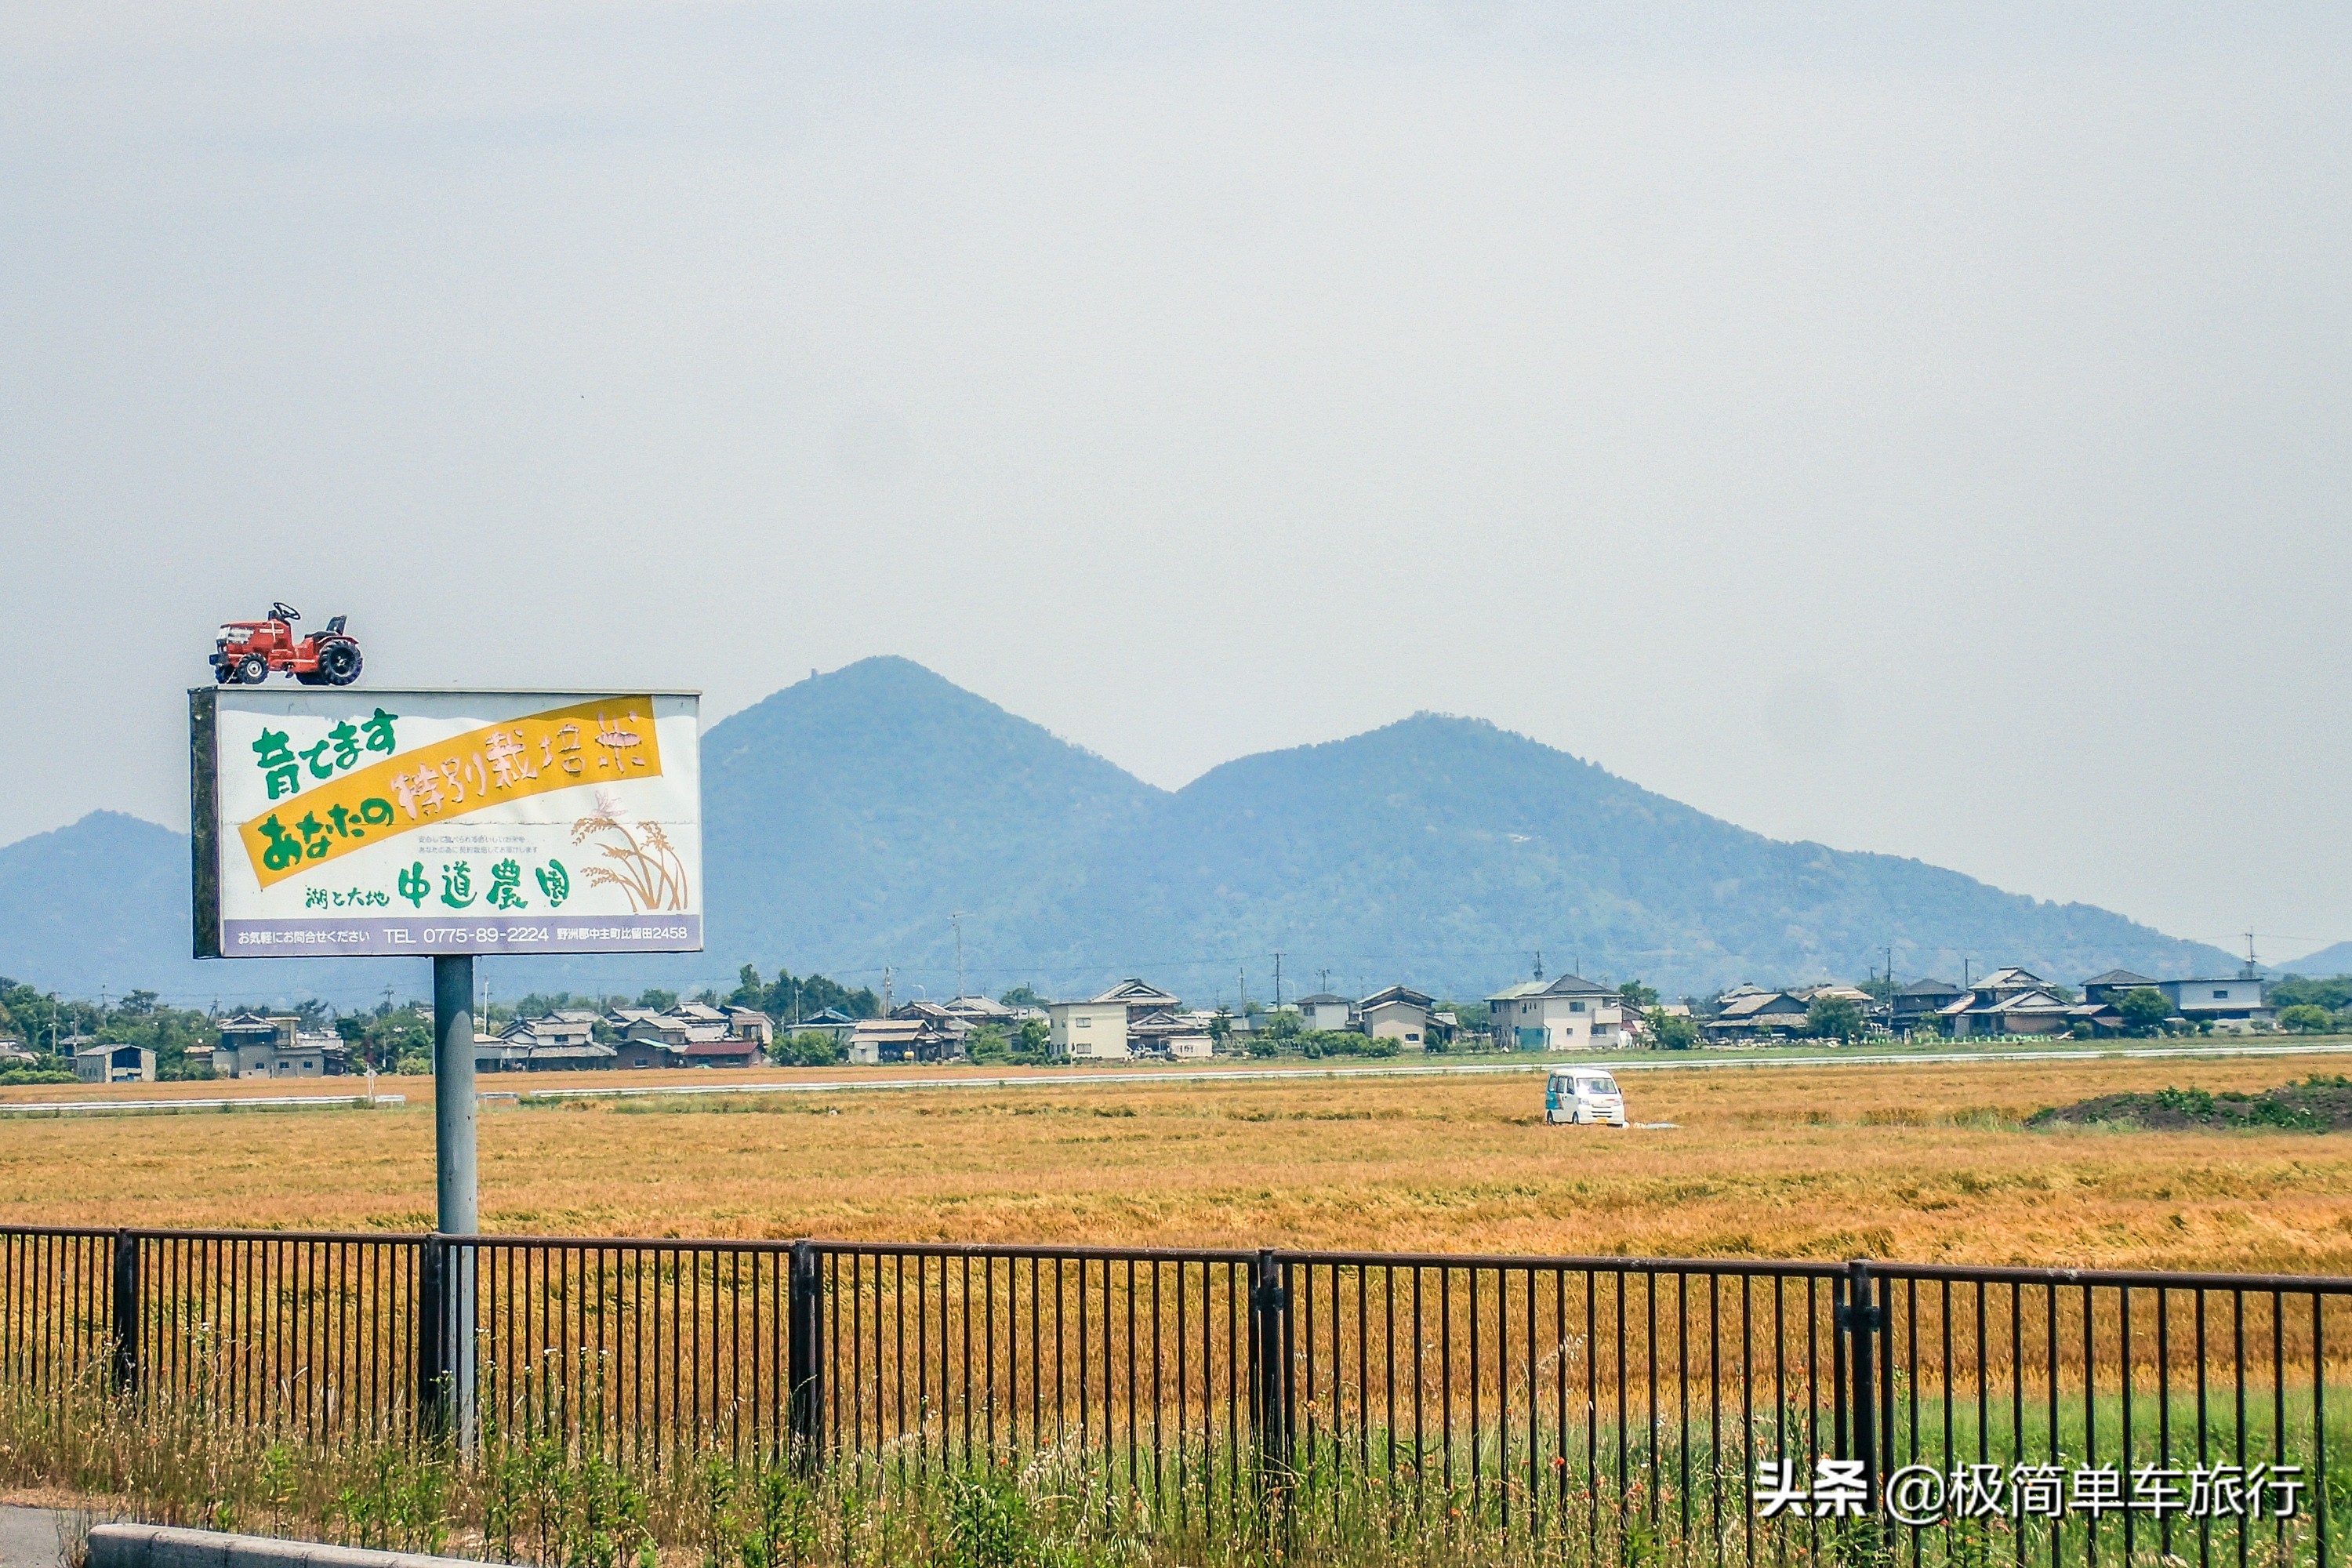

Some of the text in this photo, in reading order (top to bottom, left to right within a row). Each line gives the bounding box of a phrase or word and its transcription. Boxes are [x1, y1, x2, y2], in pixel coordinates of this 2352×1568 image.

[252, 707, 399, 800] 育てます
[398, 858, 570, 910] 中道農園
[238, 931, 370, 945] お気軽にお問合せください
[383, 928, 416, 944] TEL
[423, 927, 550, 943] 0775-89-2224
